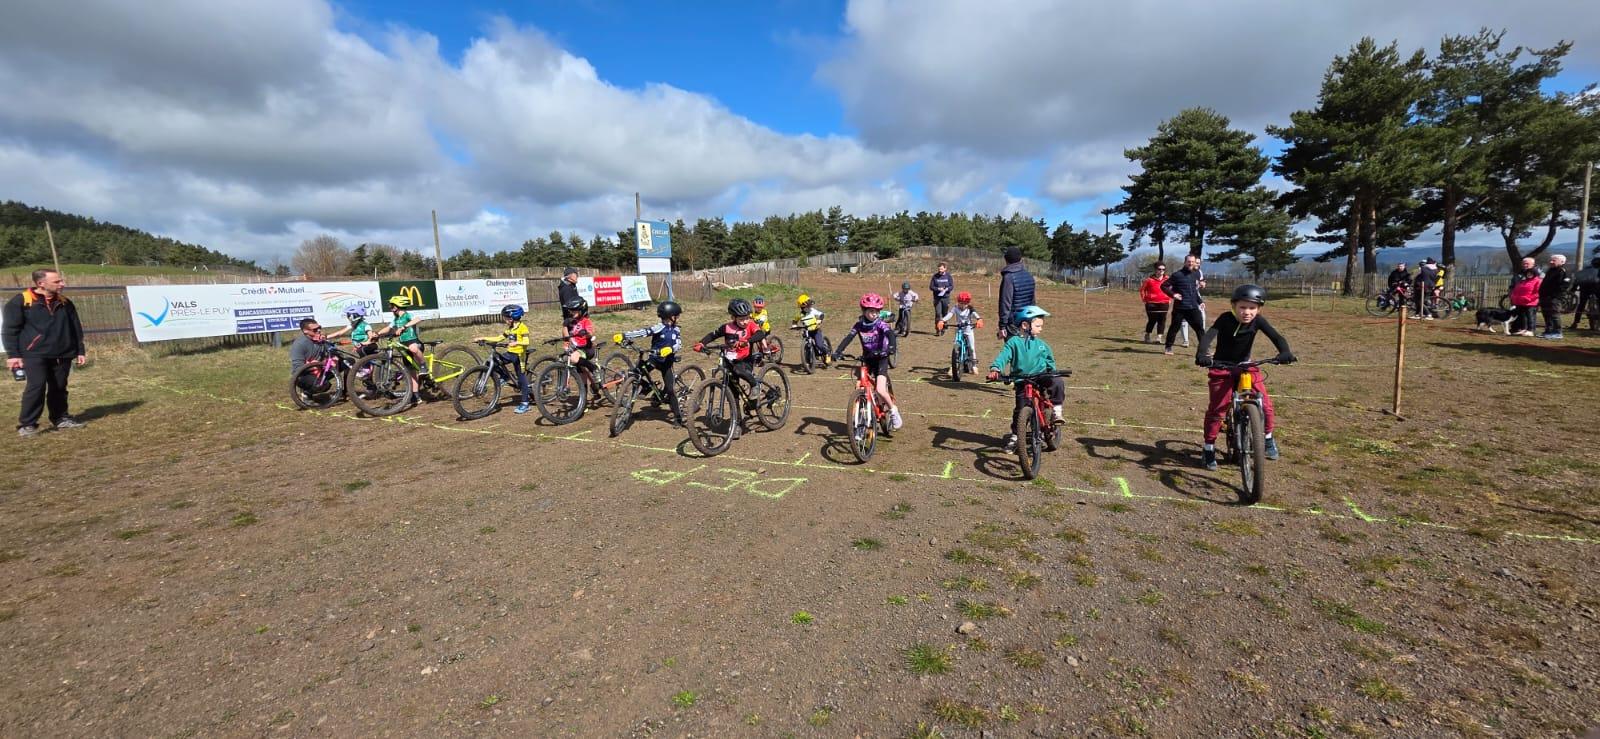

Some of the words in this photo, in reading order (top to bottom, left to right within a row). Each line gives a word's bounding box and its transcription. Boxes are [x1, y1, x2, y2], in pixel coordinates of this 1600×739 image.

[277, 286, 305, 294] Mutuel
[170, 300, 198, 308] VALS
[357, 300, 377, 309] PUY
